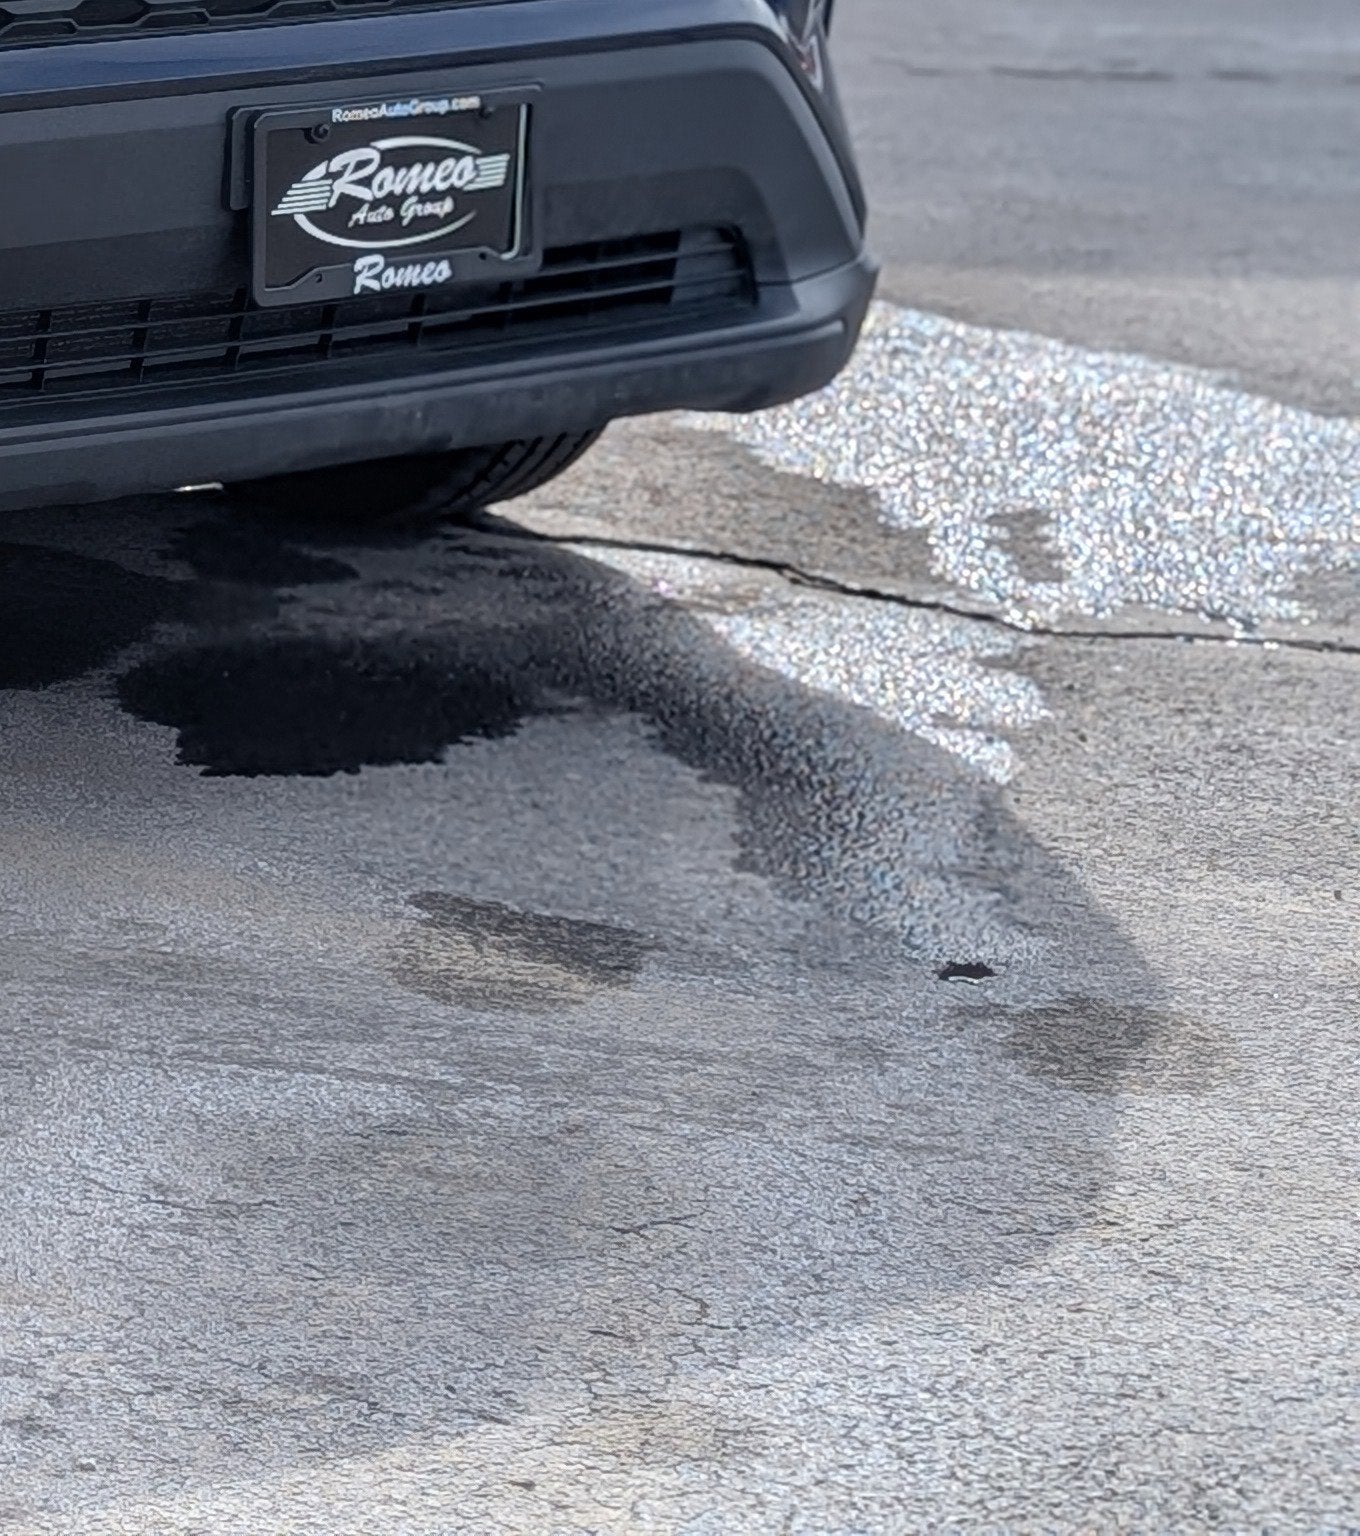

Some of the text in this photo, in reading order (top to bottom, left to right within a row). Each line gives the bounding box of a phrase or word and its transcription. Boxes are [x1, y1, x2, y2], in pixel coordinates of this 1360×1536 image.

[332, 96, 480, 122] RomeoAutoGroup.com
[328, 148, 477, 207] Romeo
[348, 195, 454, 227] Auto Group
[353, 254, 452, 294] Romeo
